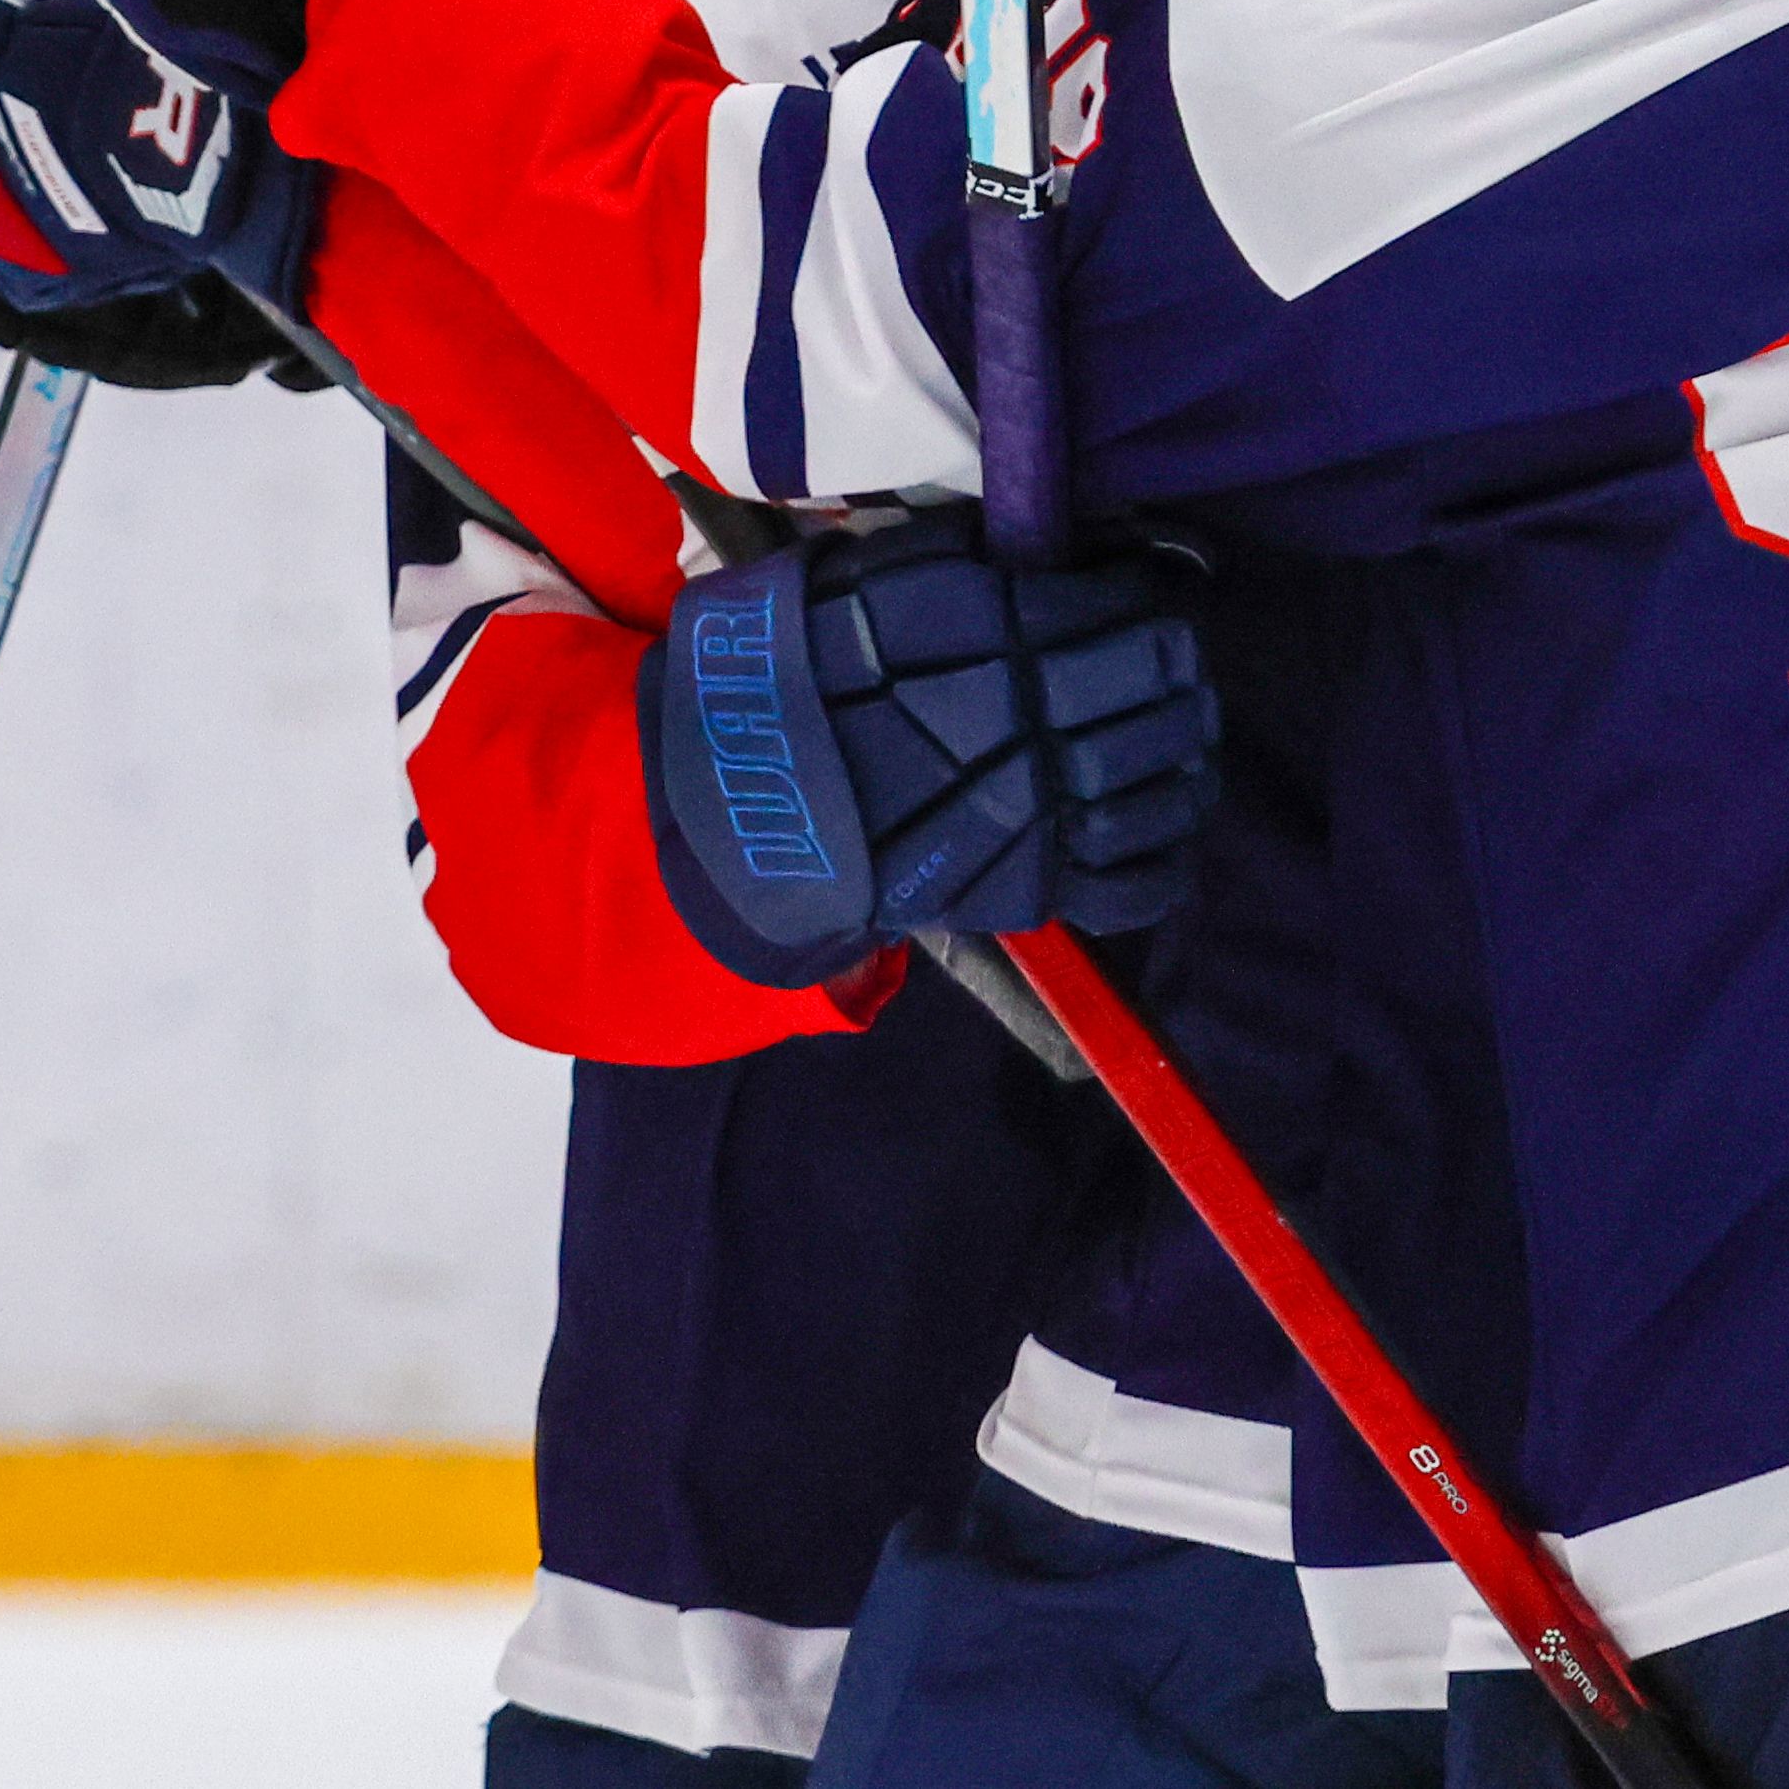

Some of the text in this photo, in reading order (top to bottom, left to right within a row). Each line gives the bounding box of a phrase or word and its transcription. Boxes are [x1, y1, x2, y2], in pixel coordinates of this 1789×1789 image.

[1409, 1444, 1470, 1515] 8 PRO
[1556, 1648, 1599, 1704] sigma
